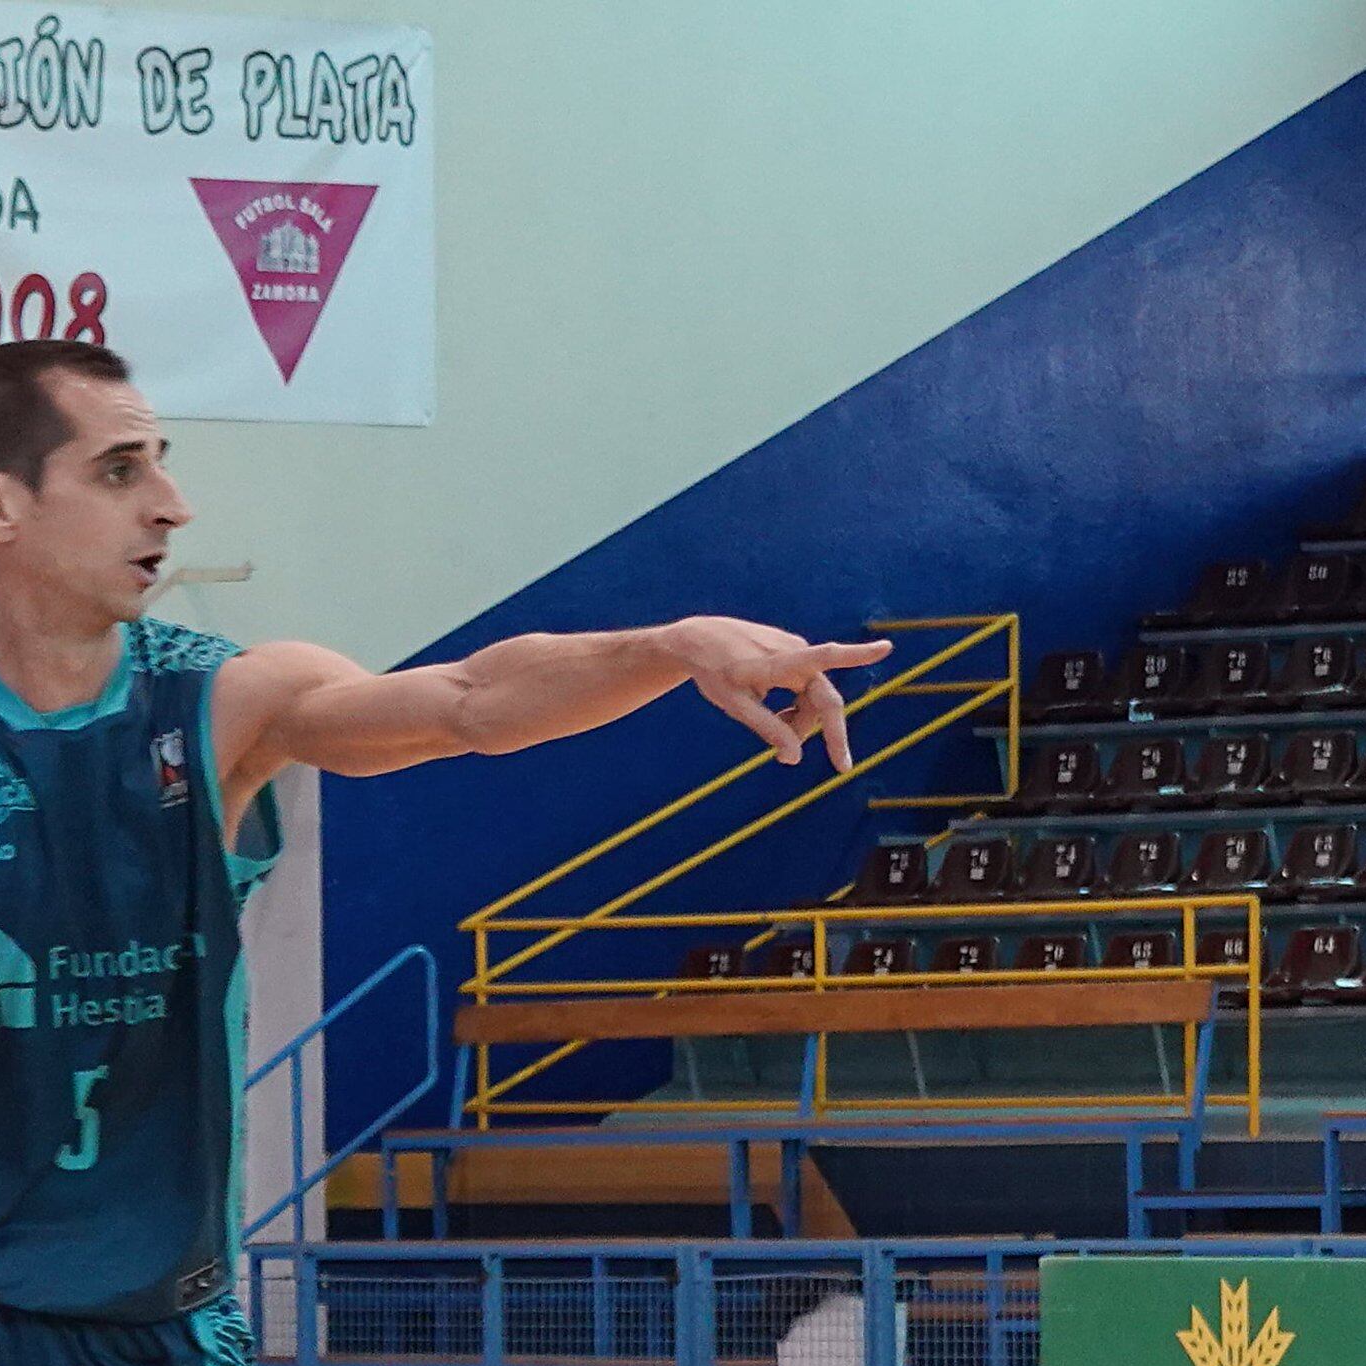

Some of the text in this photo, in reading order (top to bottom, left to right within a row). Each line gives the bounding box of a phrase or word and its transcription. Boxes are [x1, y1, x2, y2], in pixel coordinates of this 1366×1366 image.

[138, 47, 215, 135] DE
[241, 51, 417, 145] PLATA
[54, 1065, 110, 1171] 5
